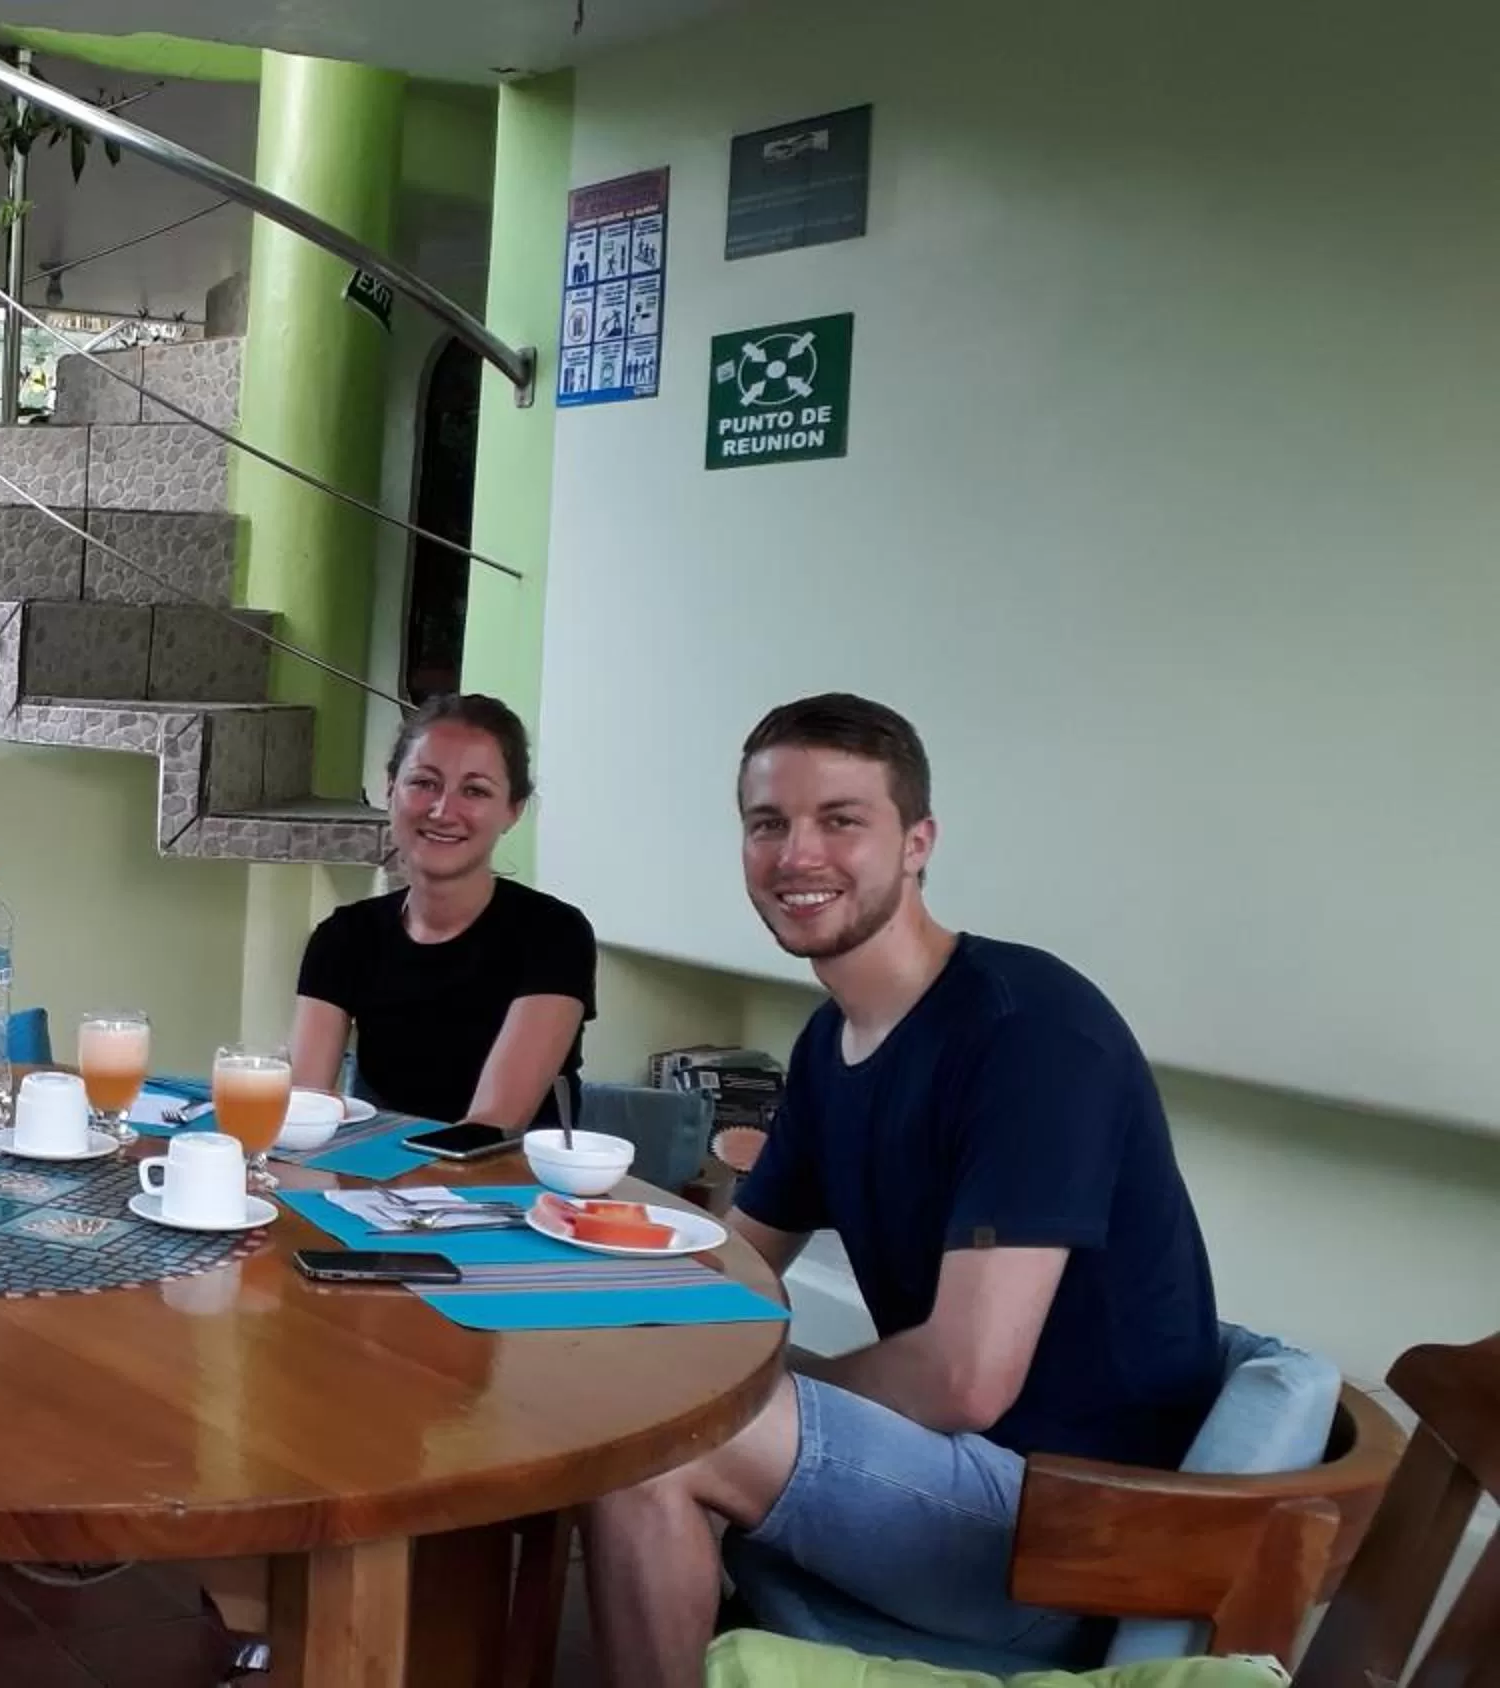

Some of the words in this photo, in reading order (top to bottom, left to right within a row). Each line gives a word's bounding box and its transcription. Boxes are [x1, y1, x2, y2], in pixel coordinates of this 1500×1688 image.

[718, 411, 794, 436] PUNTO
[801, 405, 833, 425] DE
[721, 429, 826, 457] REUNION
